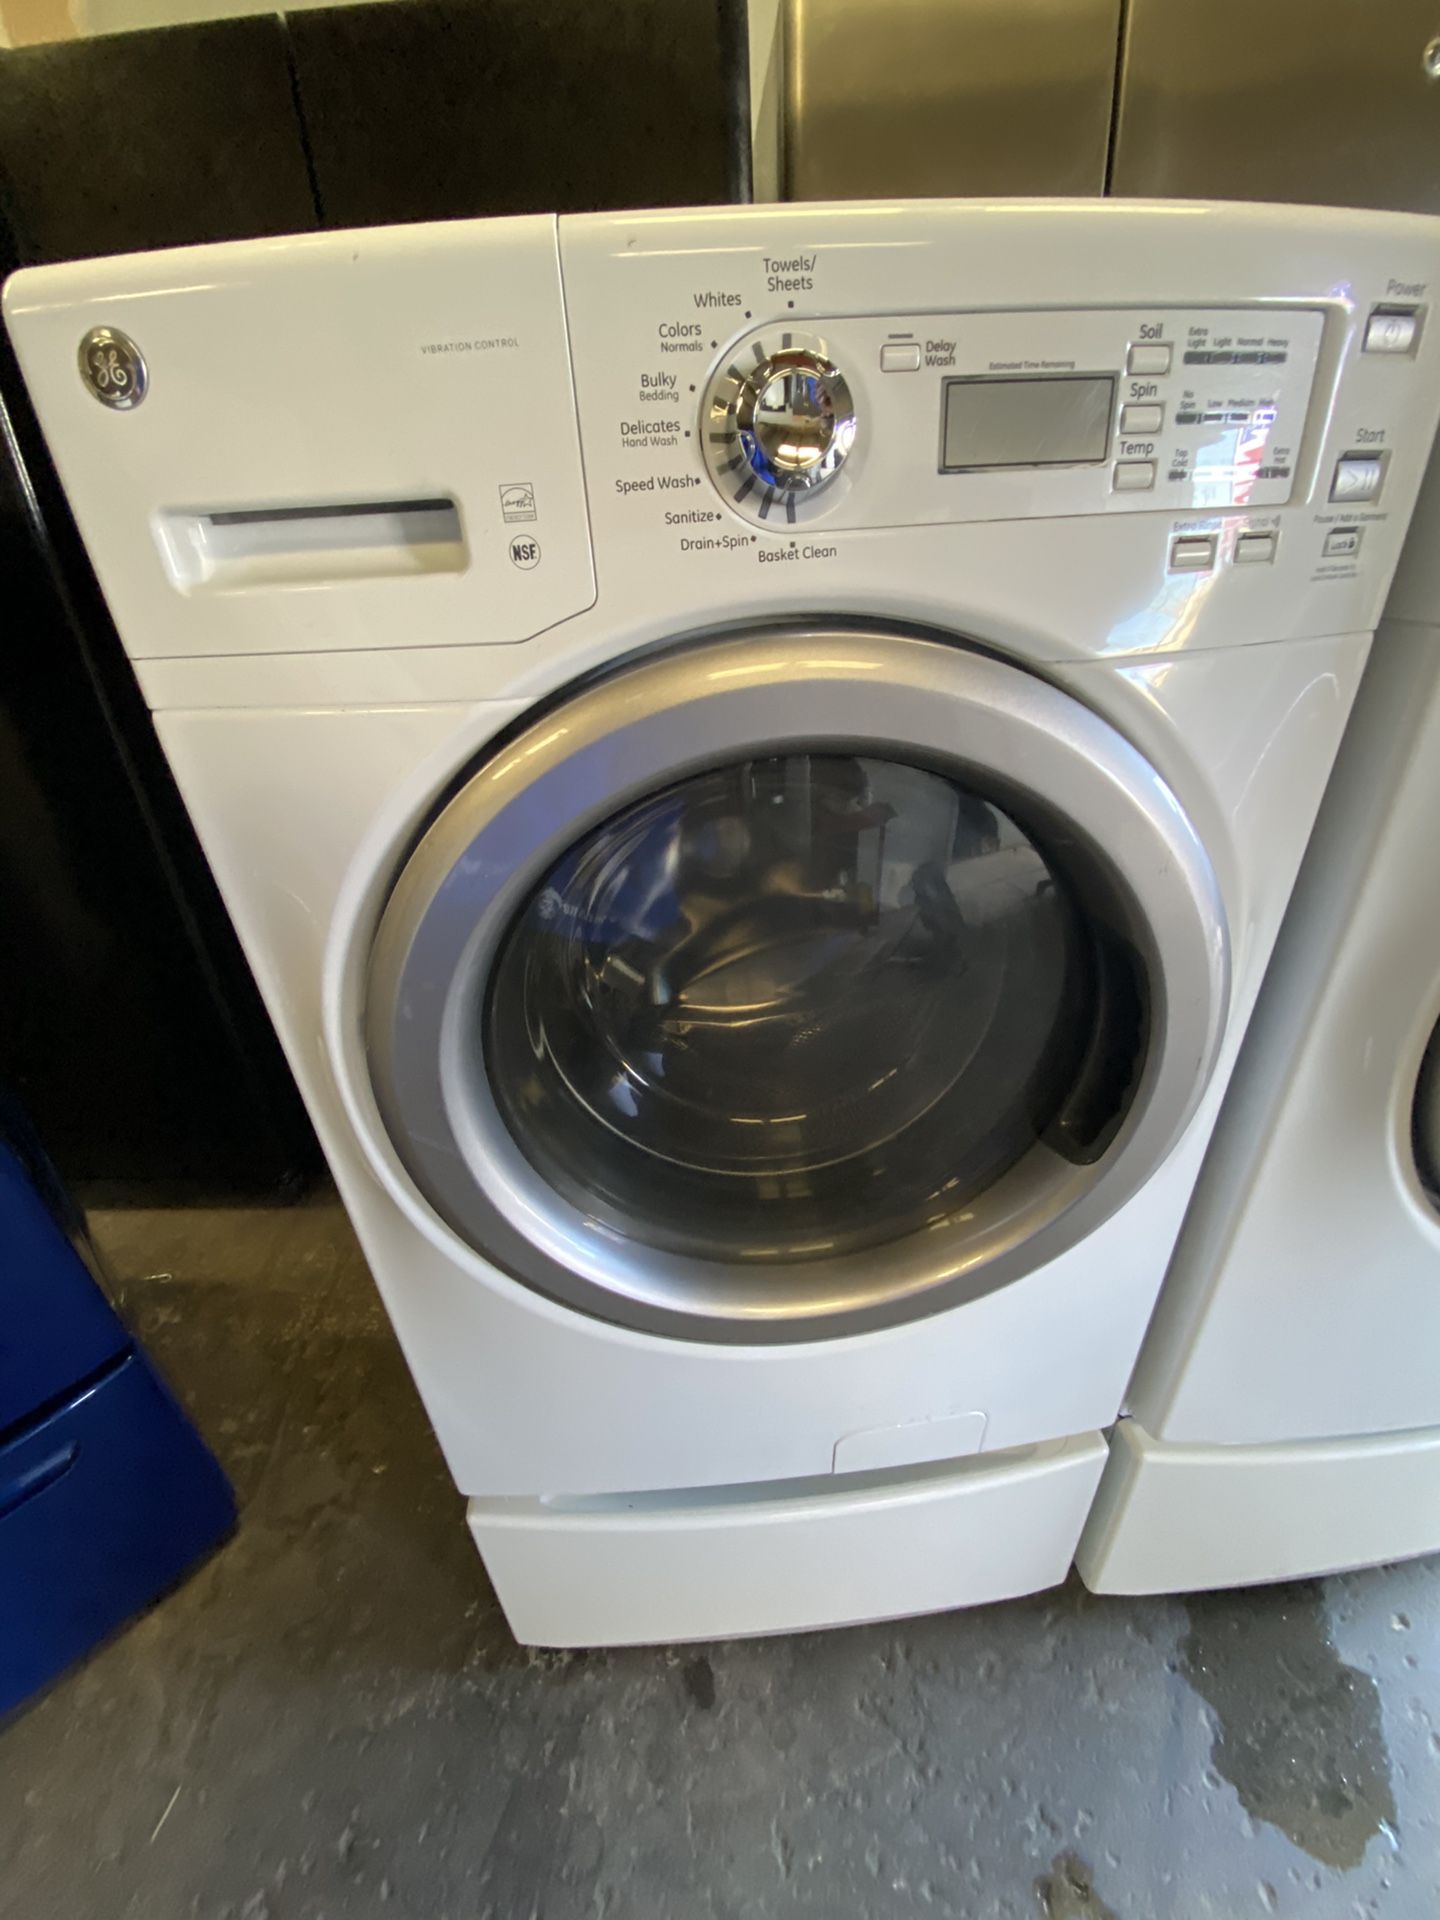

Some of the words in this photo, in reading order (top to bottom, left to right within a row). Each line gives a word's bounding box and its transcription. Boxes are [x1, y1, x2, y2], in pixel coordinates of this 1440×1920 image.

[763, 255, 817, 274] Towels/
[767, 275, 813, 292] Sheets
[1387, 279, 1426, 297] Power
[693, 291, 742, 308] Whites
[658, 322, 702, 338] Colors
[1139, 323, 1164, 339] Soil
[420, 342, 472, 354] VIBRATION
[474, 337, 519, 350] CONTROL
[660, 340, 703, 353] Normals
[926, 339, 956, 354] Delay
[925, 354, 956, 367] Wash
[641, 371, 677, 388] Bulky
[639, 388, 679, 403] Bedding
[1130, 382, 1157, 400] Spin
[620, 419, 681, 436] Delicates
[1355, 427, 1385, 443] Start
[622, 436, 648, 448] Hand
[650, 435, 678, 447] Wash
[1120, 441, 1154, 457] Temp
[615, 476, 655, 496] Speed
[656, 473, 695, 490] Wash
[665, 509, 714, 525] Sanitize
[680, 534, 749, 551] Drain+Spin
[512, 543, 536, 561] NSF
[758, 547, 799, 563] Basket
[802, 545, 837, 560] Clean
